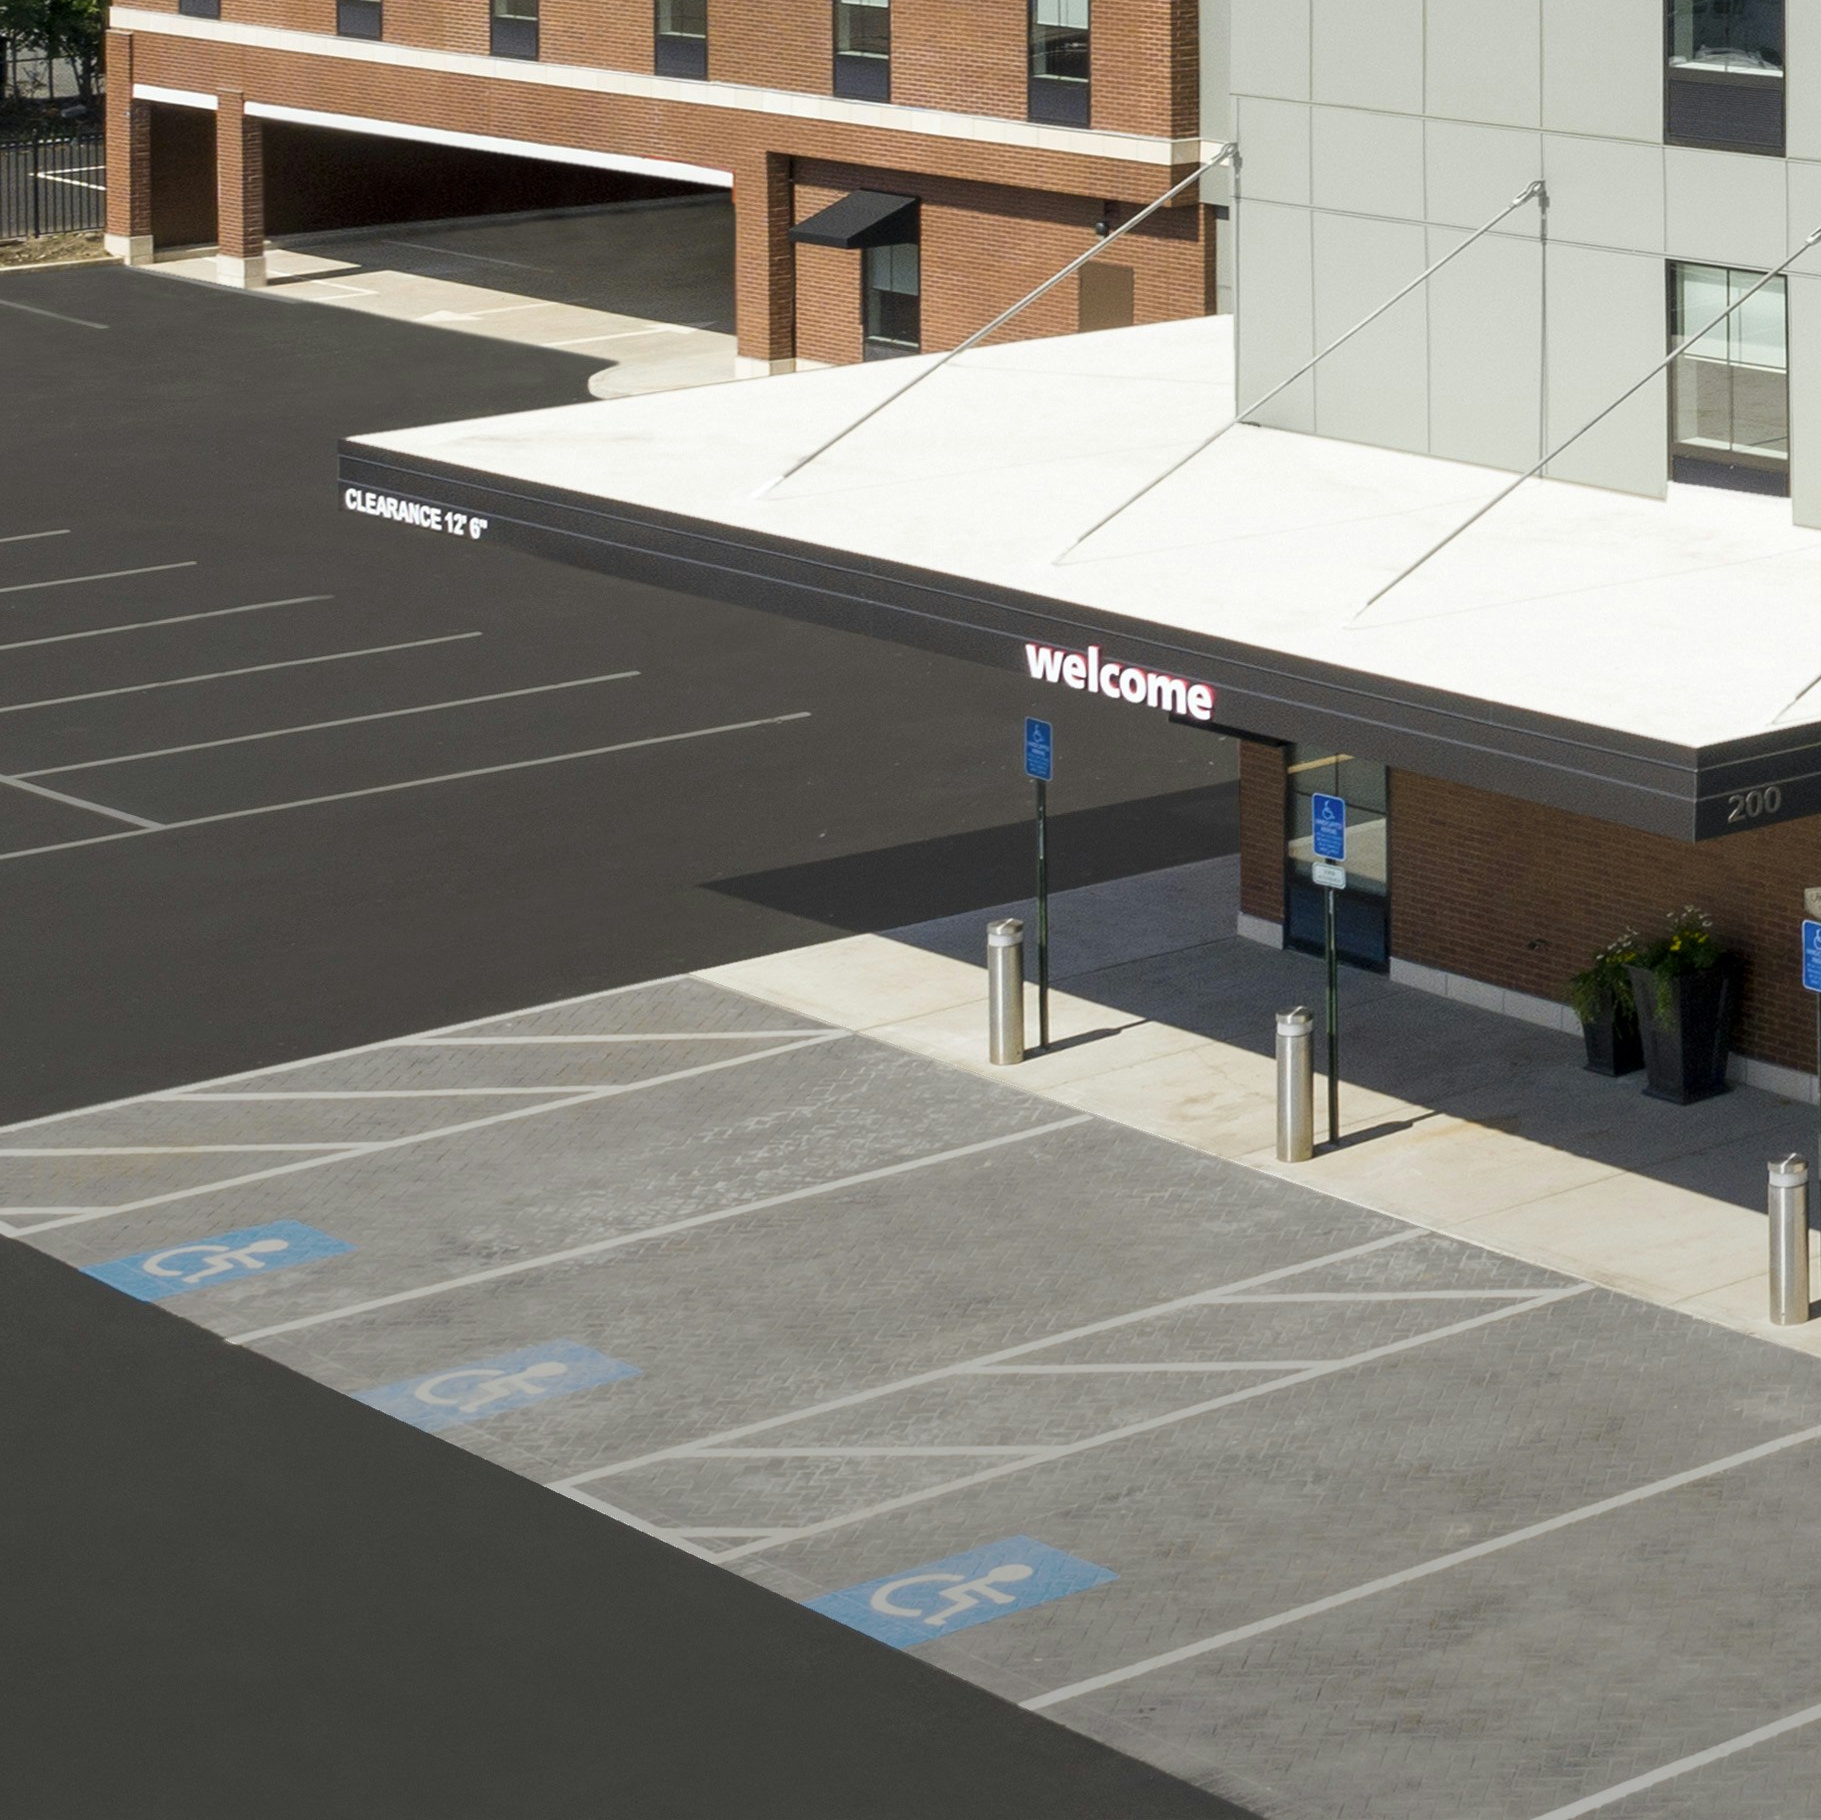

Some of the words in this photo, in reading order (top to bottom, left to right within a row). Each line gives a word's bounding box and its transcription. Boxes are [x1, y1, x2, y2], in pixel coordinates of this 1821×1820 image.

[344, 487, 443, 531] CLEARANCE
[444, 511, 468, 536] 12'
[1024, 642, 1216, 722] welcome
[1727, 786, 1782, 824] 200
